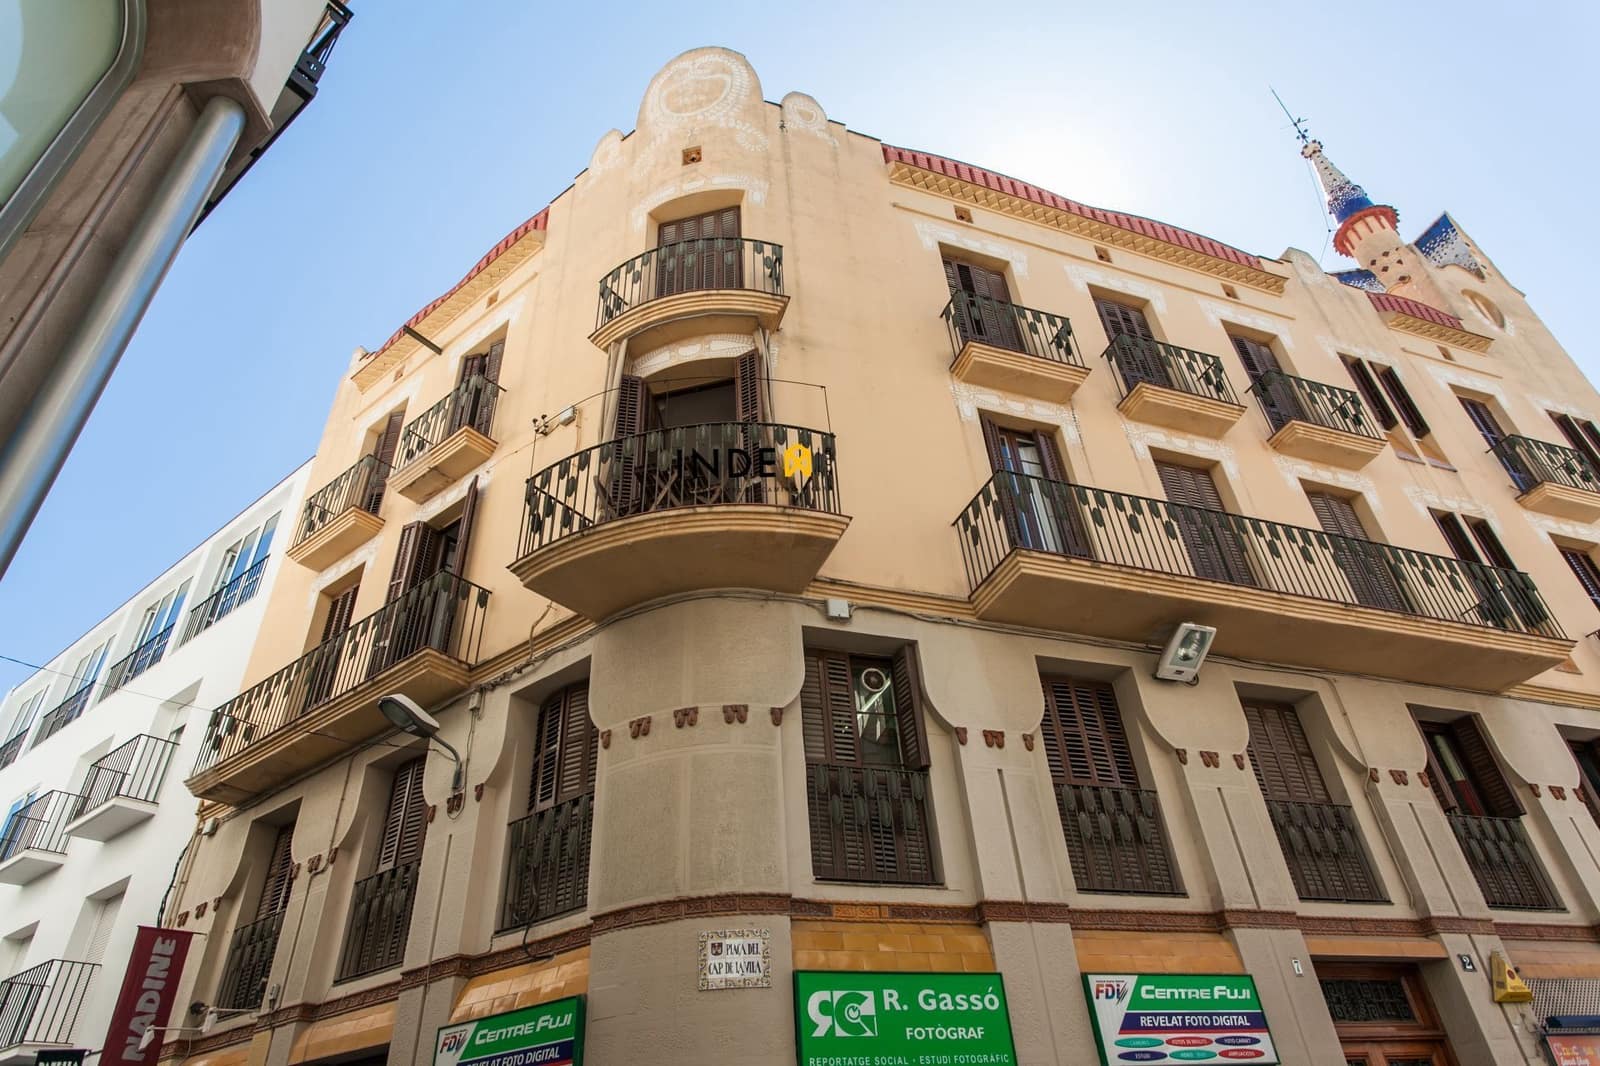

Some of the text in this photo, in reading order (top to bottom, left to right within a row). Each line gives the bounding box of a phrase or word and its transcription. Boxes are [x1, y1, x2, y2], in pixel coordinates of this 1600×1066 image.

[708, 962, 724, 976] CAP
[725, 962, 734, 974] DE
[745, 960, 762, 974] VILA
[1462, 955, 1473, 970] 2
[121, 935, 177, 1061] NADINE
[882, 986, 1000, 1011] R. Gassó
[1140, 1015, 1251, 1027] REVELAT FOTO DIGITAL
[501, 1053, 525, 1066] FOTO
[525, 1046, 561, 1064] DIGITAL
[809, 1057, 871, 1066] REPORTATGE
[874, 1056, 909, 1065] SOCIAL
[919, 1055, 951, 1064] ESTUDI
